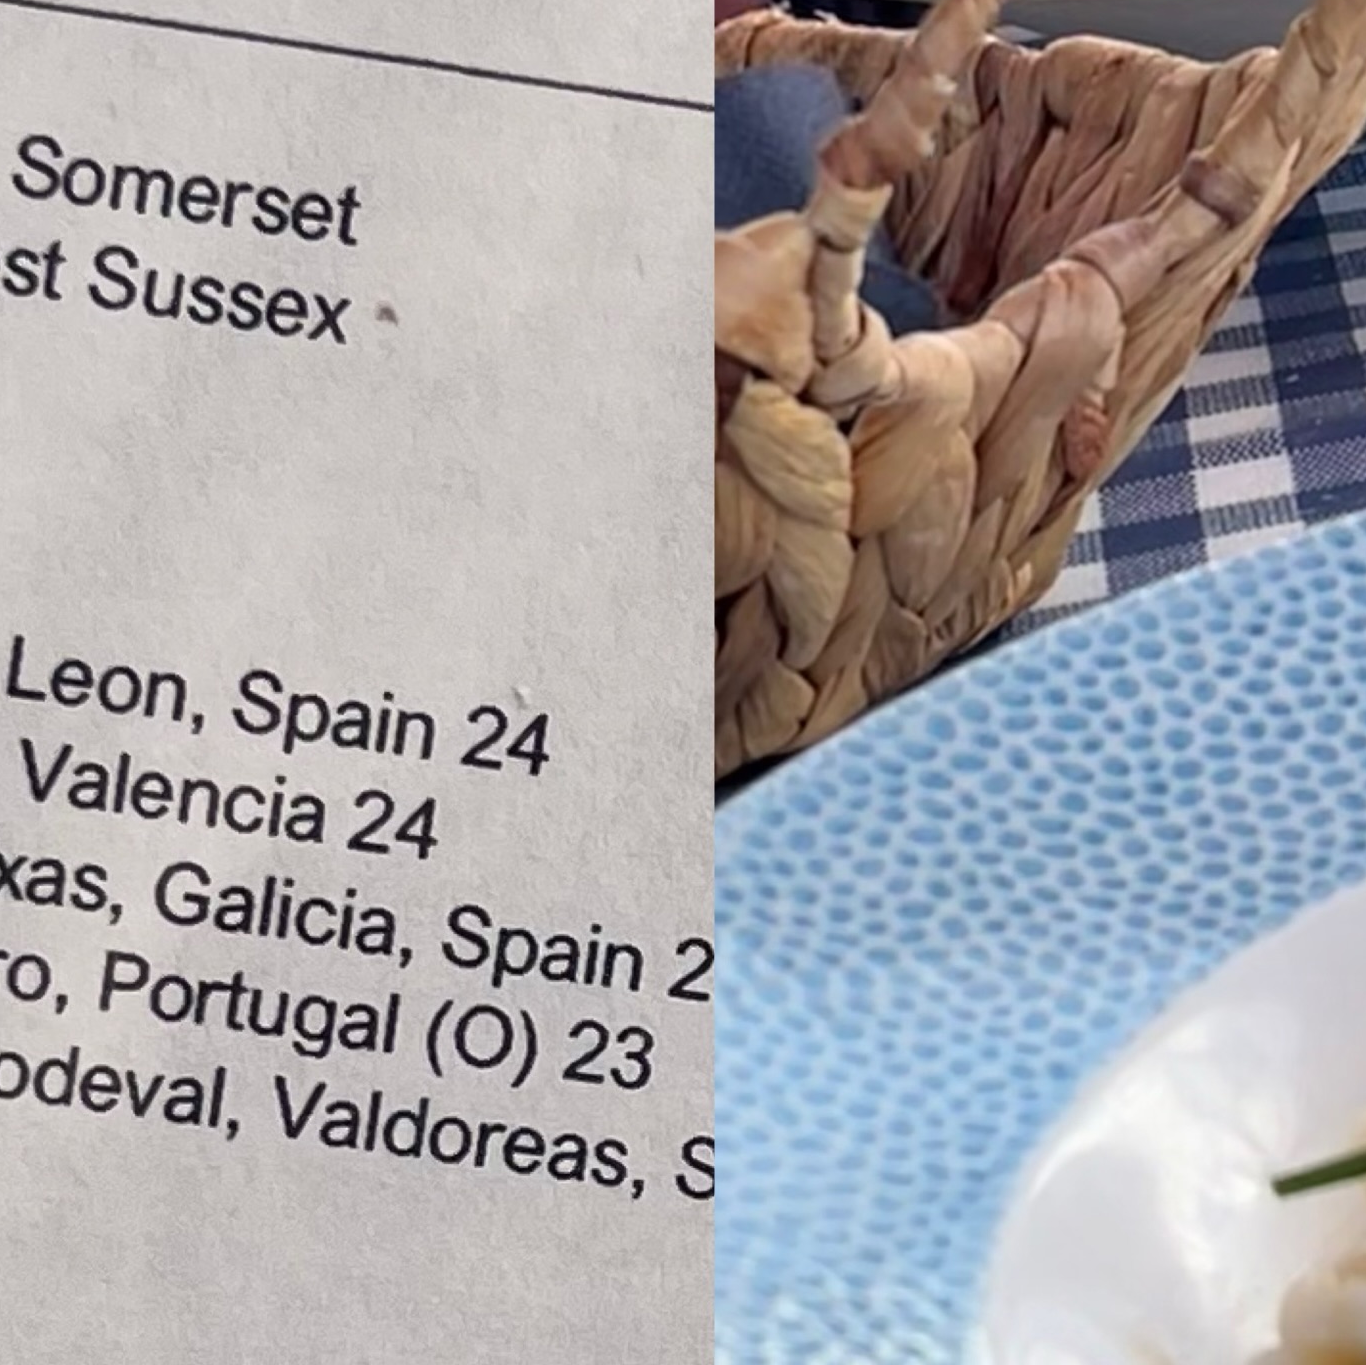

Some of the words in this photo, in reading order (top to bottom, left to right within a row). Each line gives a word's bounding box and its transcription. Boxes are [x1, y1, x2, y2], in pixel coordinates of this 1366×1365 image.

[11, 134, 361, 246] Somerset
[87, 245, 351, 344] Sussex
[6, 634, 204, 735] Leon,
[231, 669, 435, 760] Spain
[459, 705, 549, 776] 24
[19, 738, 325, 843] Valencia
[347, 789, 438, 860] 24
[154, 861, 412, 969] Galicia,
[442, 904, 644, 992] Spain
[99, 950, 401, 1059] Portugal
[426, 999, 538, 1088] (O)
[562, 1019, 654, 1090] 23
[274, 1075, 644, 1200] Valdoreas,
